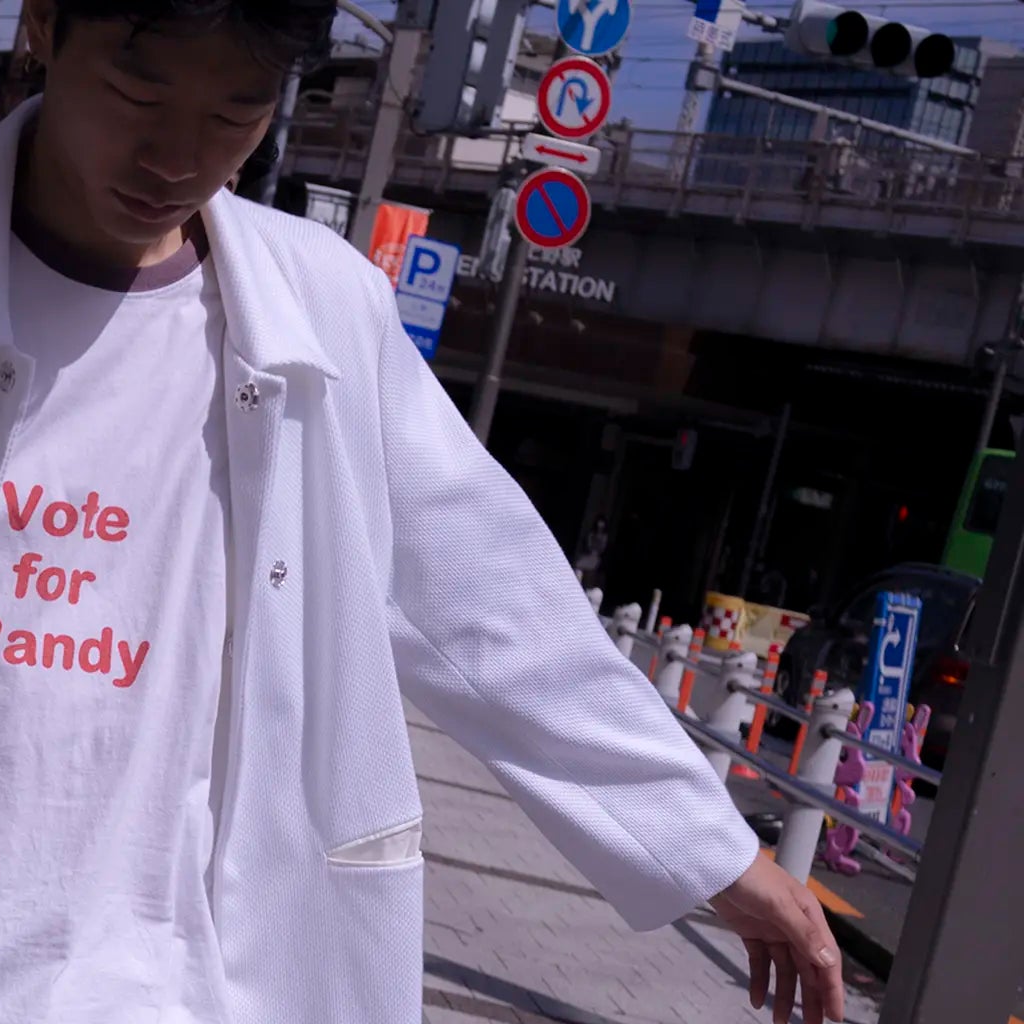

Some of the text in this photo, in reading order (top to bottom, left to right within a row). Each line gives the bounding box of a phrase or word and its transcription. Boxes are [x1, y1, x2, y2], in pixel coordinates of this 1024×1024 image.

[406, 245, 441, 285] P
[2, 480, 130, 542] Vote
[12, 552, 97, 605] for
